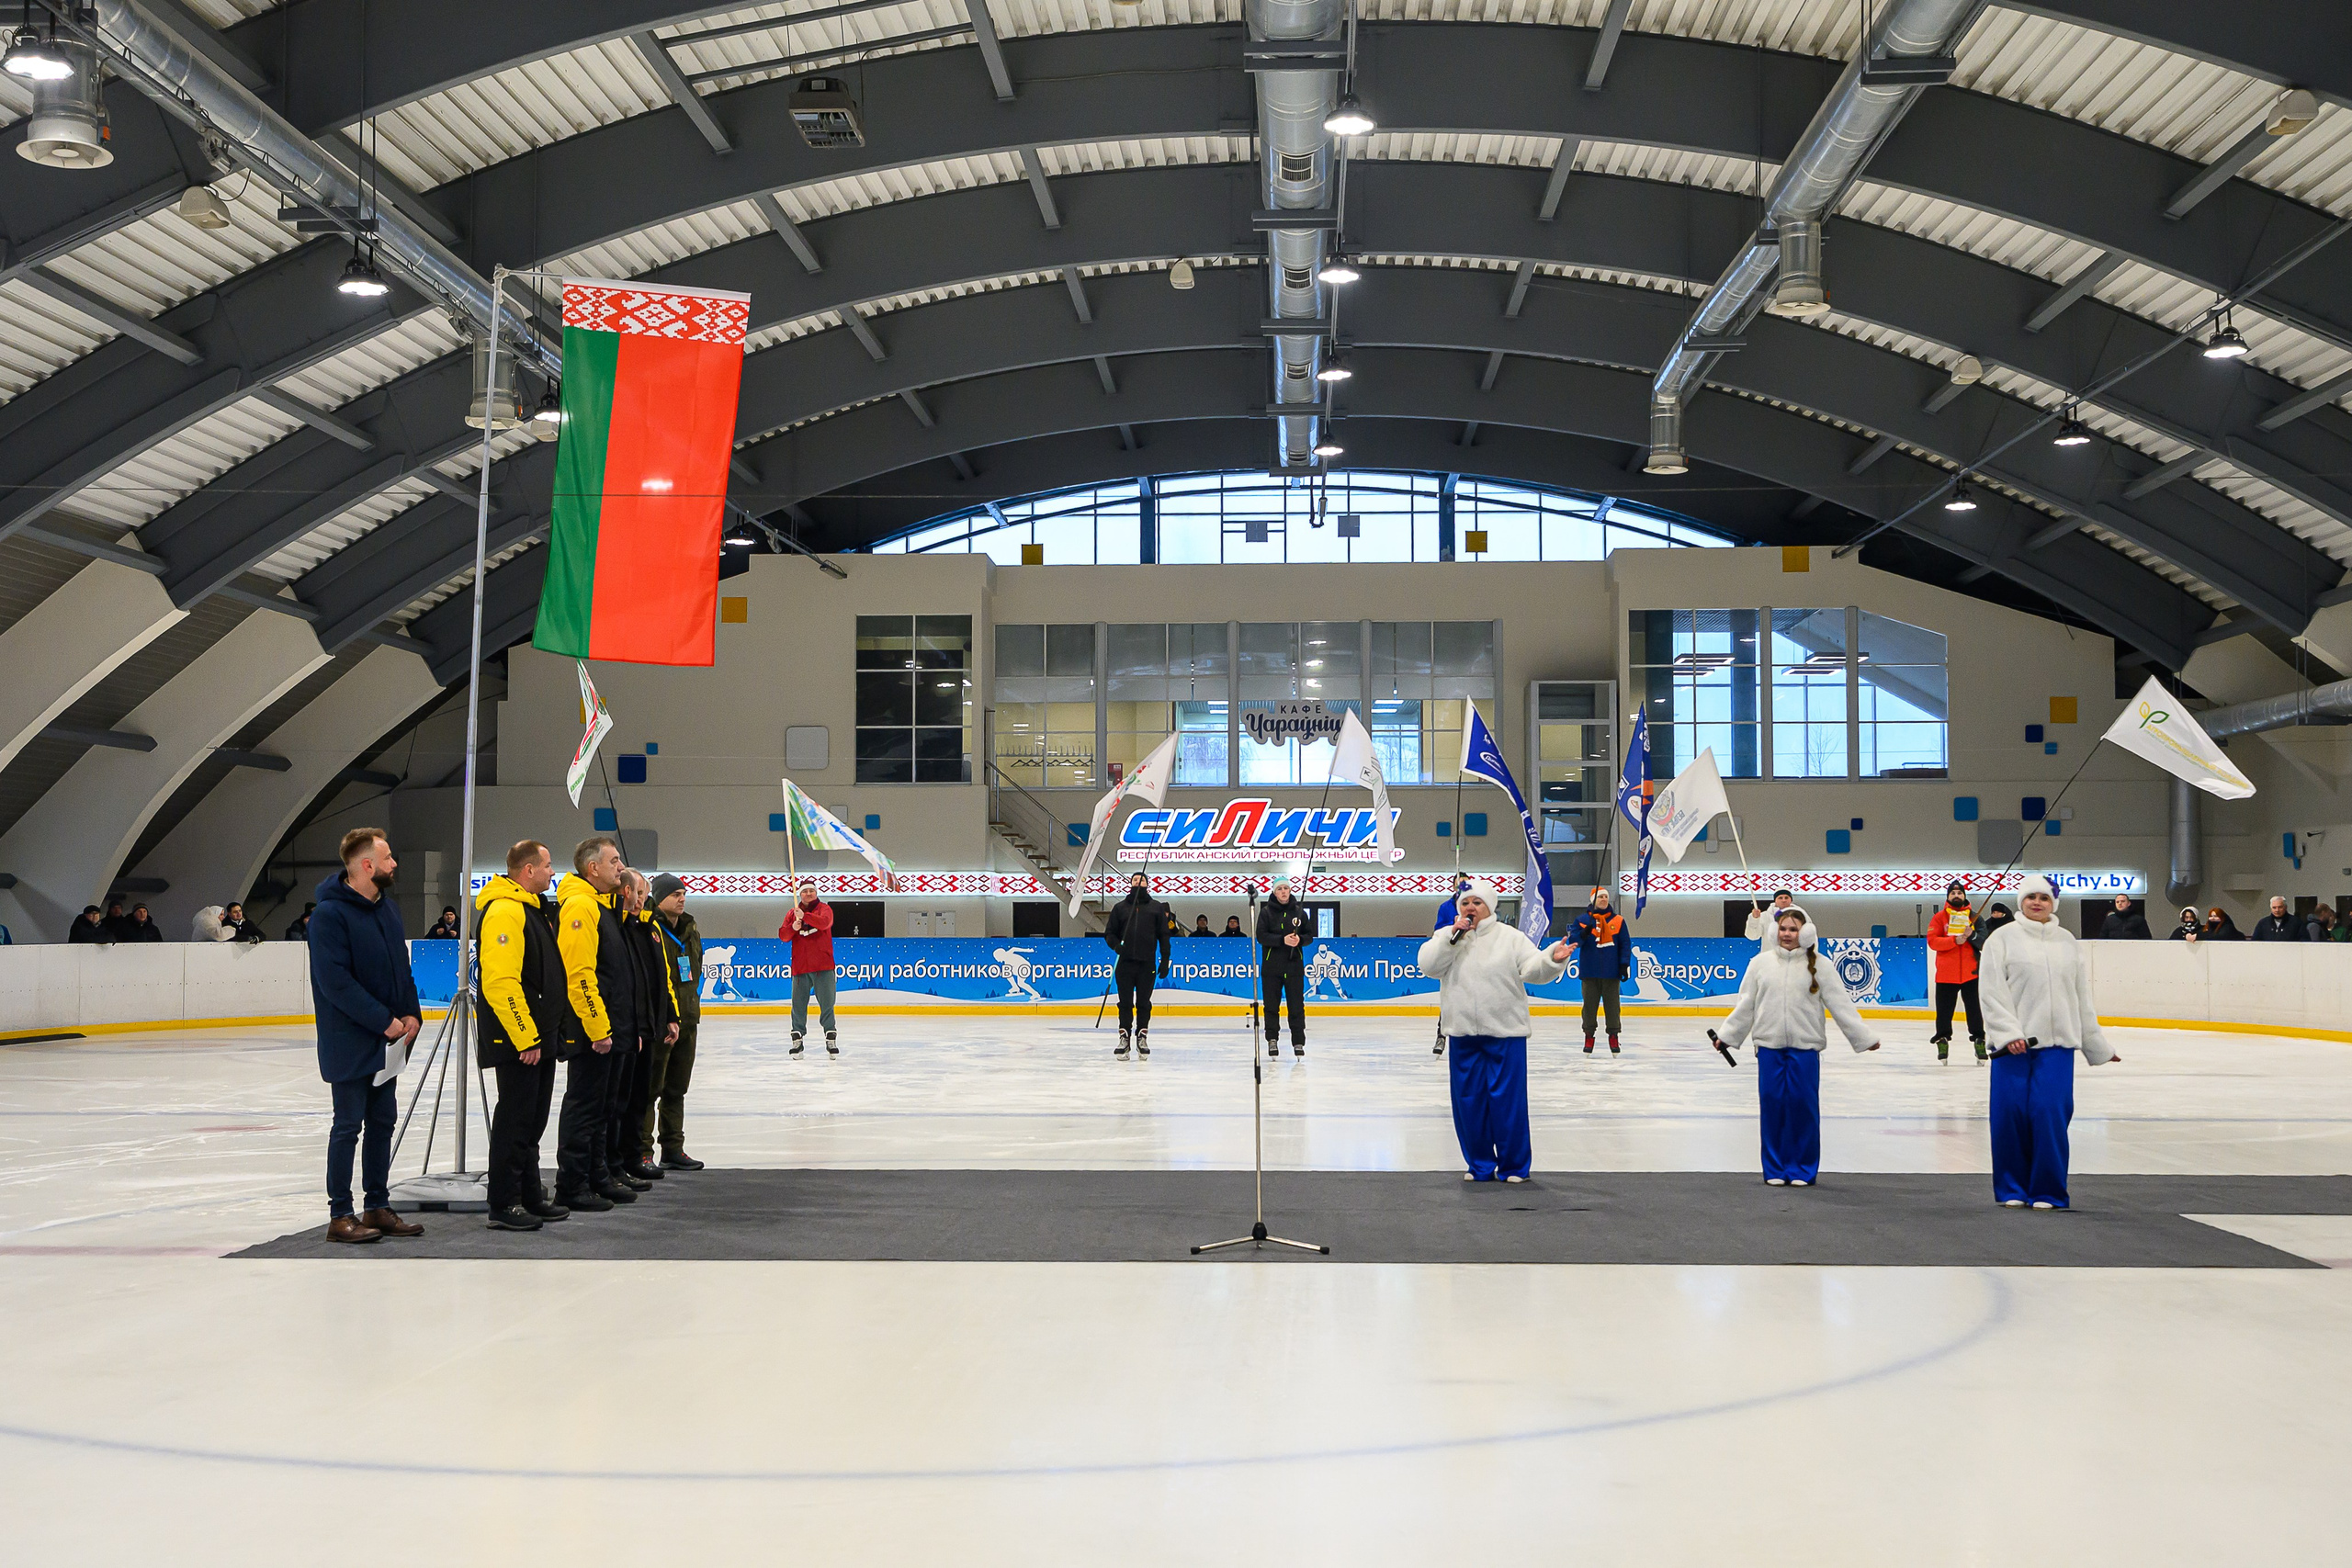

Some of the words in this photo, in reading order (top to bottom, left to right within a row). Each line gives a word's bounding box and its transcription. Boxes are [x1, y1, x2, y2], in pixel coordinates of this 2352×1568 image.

[1281, 705, 1322, 714] КАФЕ
[1245, 713, 1345, 741] Чараўніц
[1120, 849, 1250, 860] РЕСПУБЛИКАНСКИЙ
[1361, 851, 1402, 860] ЦЕТР
[835, 964, 884, 982] реди
[889, 959, 1012, 983] работников
[1018, 964, 1114, 983] организа
[1159, 960, 1260, 983] правлен
[1304, 963, 1368, 979] елами
[1636, 959, 1737, 984] Беларусь
[581, 979, 598, 1018] BELARUS
[508, 996, 526, 1032] BELARUS
